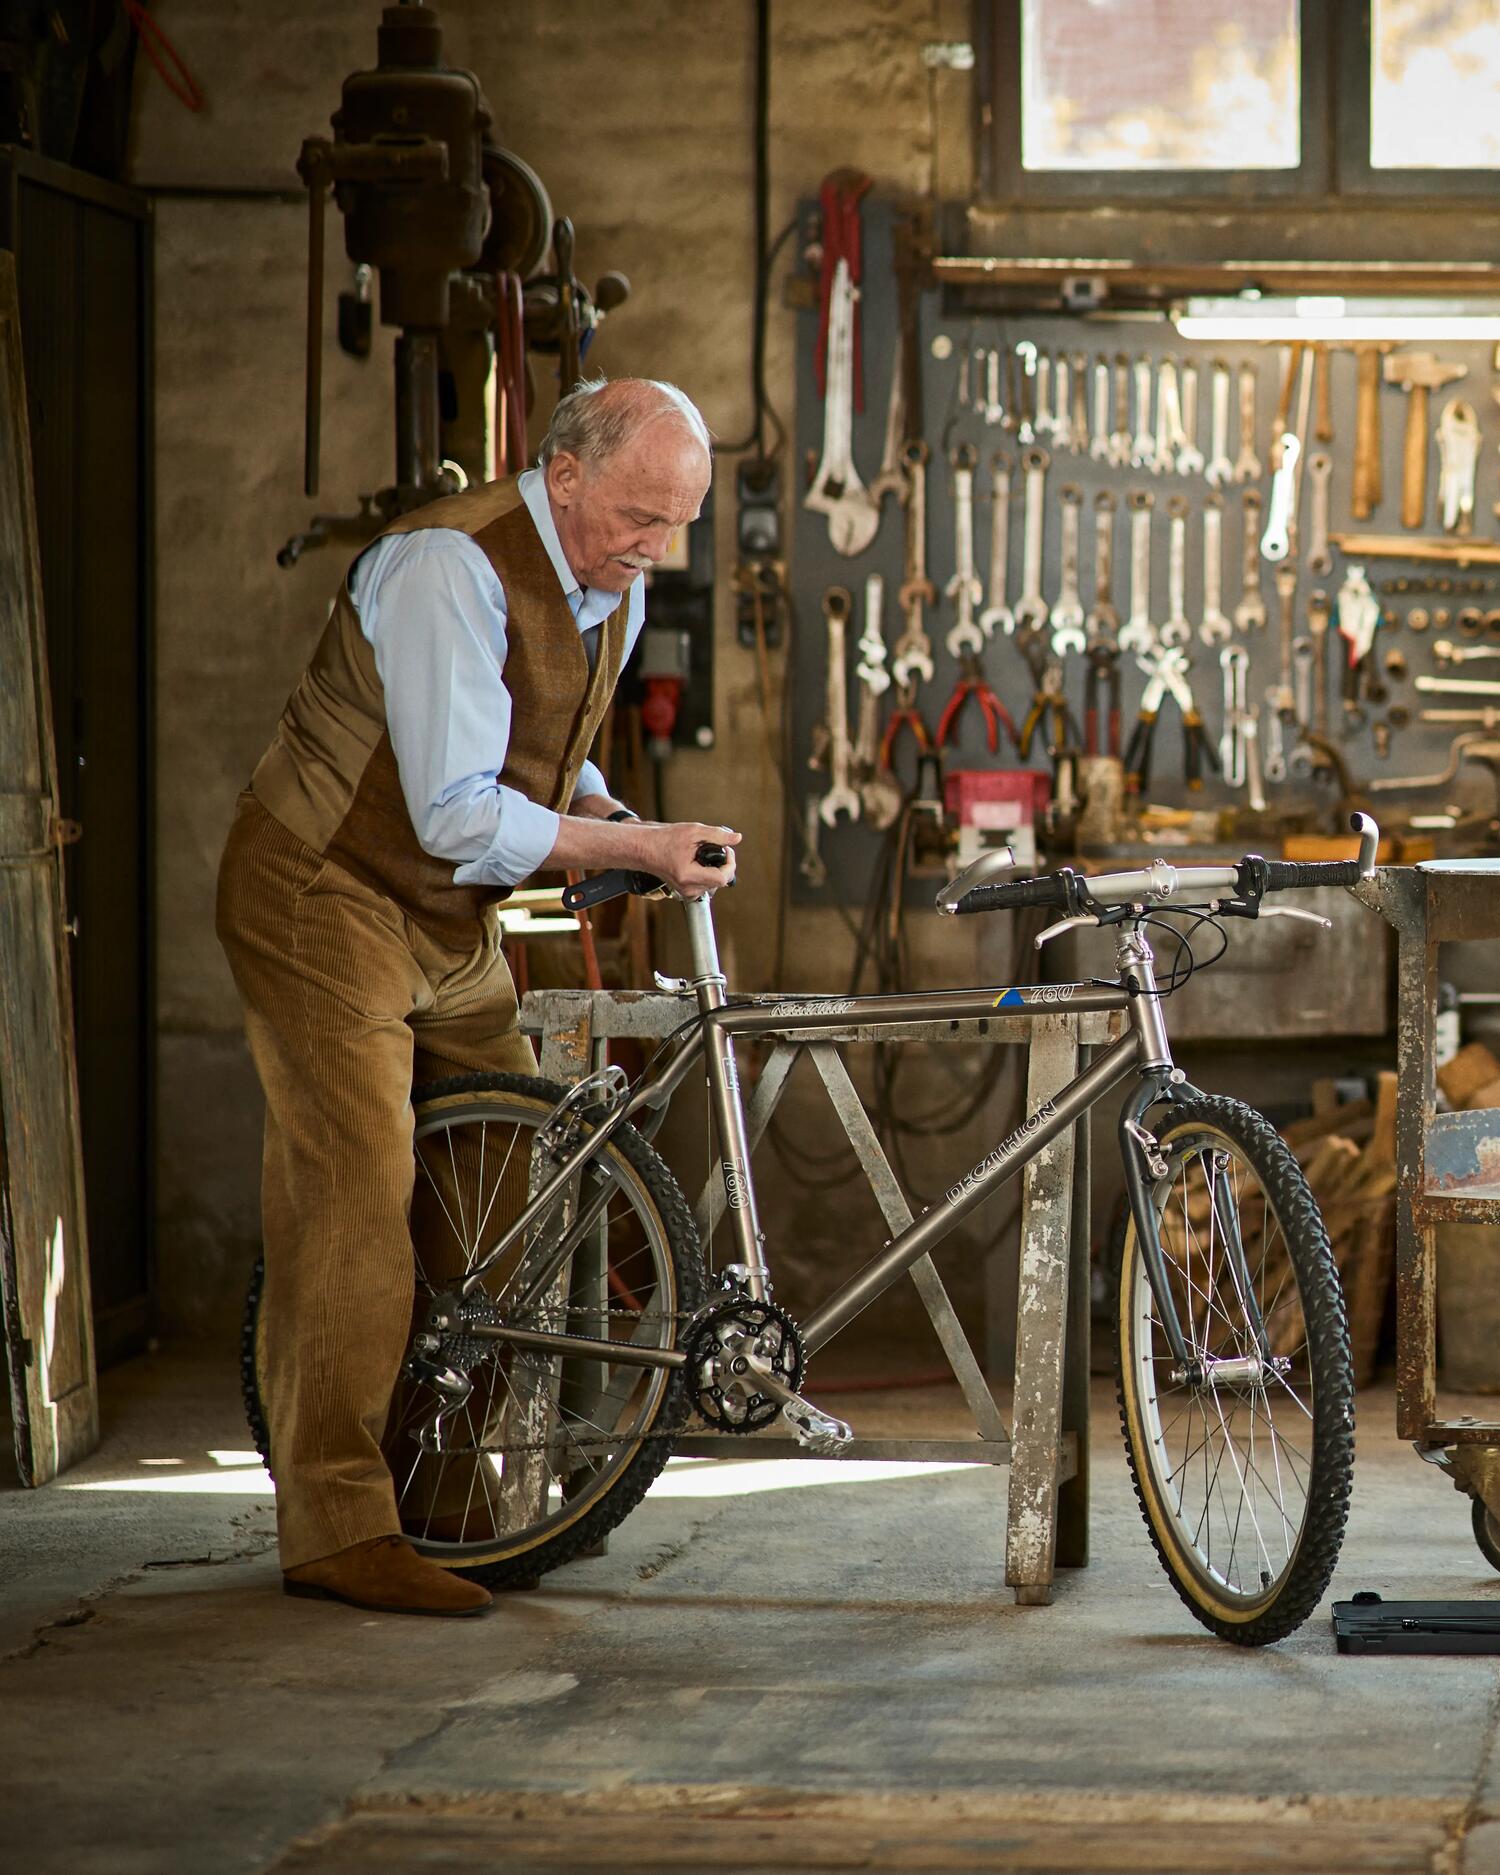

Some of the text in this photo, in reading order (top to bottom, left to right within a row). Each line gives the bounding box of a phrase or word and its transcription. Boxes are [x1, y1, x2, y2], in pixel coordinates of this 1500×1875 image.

[1030, 985, 1075, 1003] 760
[945, 1100, 1057, 1207] DECATHLON
[723, 1157, 749, 1209] 760
